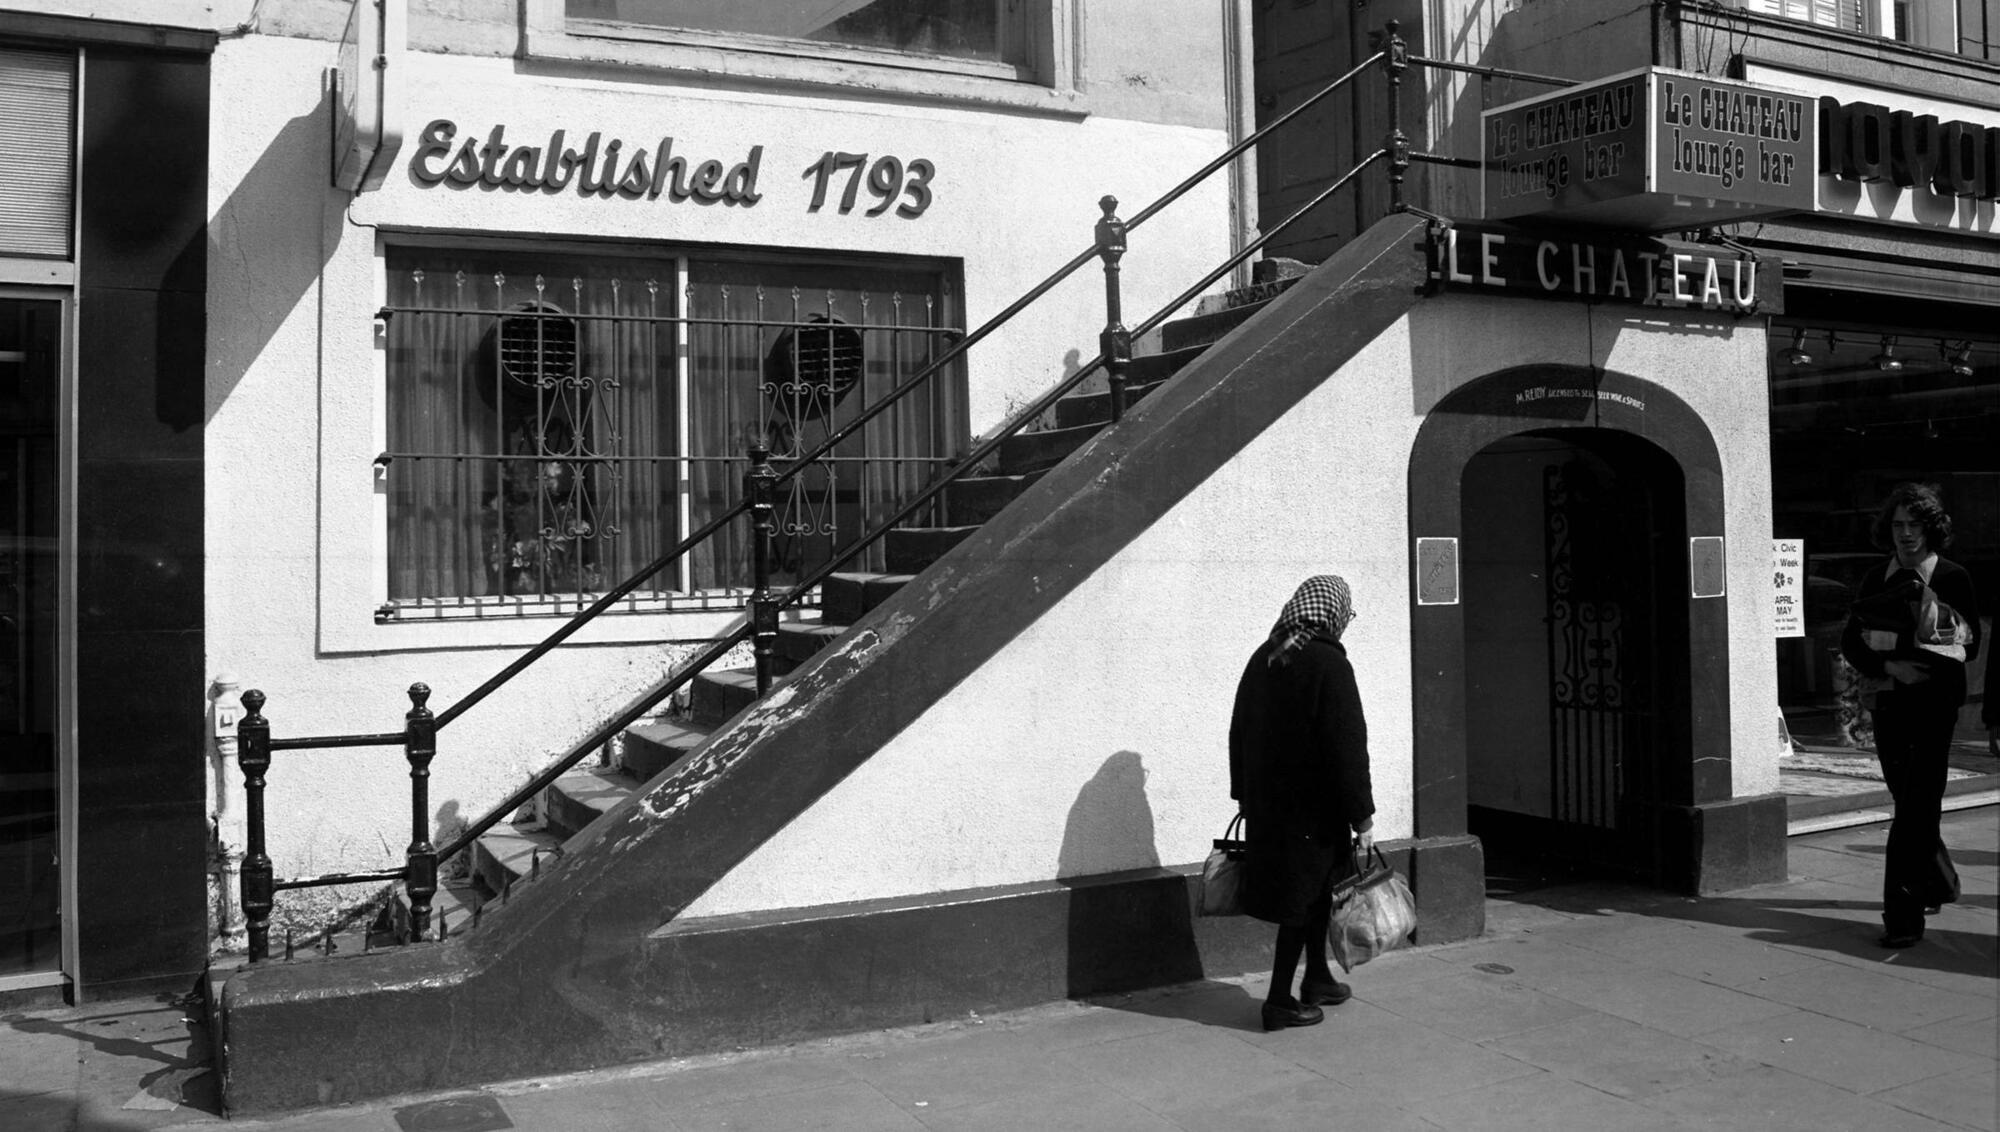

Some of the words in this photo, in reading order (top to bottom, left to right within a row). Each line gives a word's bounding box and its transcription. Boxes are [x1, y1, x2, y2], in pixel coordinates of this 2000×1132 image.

[1493, 118, 1519, 159] Le
[1524, 83, 1634, 151] CHATEAU
[1664, 81, 1692, 128] Le
[1700, 87, 1803, 143] CHATEAU
[408, 119, 763, 207] Established
[802, 151, 936, 219] 1793
[1501, 151, 1570, 199] lounge
[1583, 139, 1624, 182] bar
[1673, 128, 1745, 189] lounge
[1758, 140, 1794, 186] bar
[1448, 228, 1507, 287] LE
[1536, 239, 1757, 308] CHATEAU
[1780, 558, 1799, 567] Week
[1781, 543, 1797, 552] Civic
[1776, 606, 1792, 615] MAY
